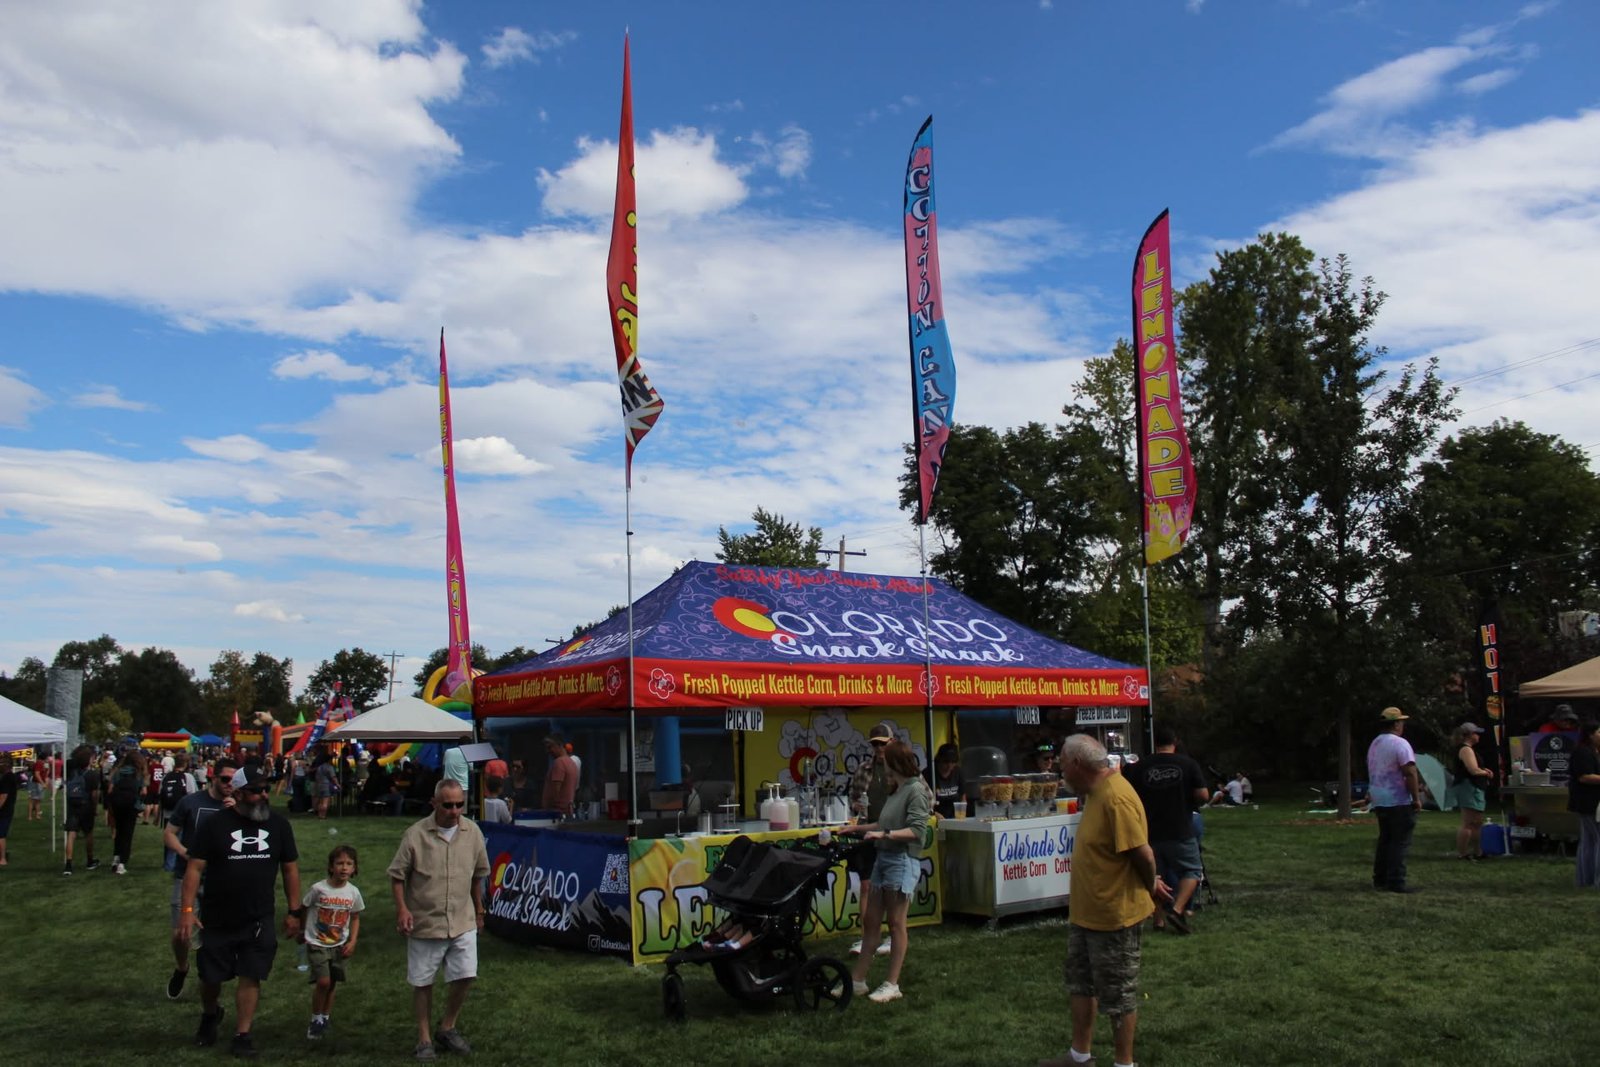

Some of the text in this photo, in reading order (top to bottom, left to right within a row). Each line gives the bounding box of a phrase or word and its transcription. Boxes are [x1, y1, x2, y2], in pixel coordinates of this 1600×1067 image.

[909, 164, 935, 337] COTTON
[1141, 247, 1187, 499] LEMONADE
[918, 346, 951, 480] CAN
[712, 596, 1008, 642] COLORADO
[771, 632, 1024, 662] Snack Shack
[1481, 624, 1499, 693] HOT
[486, 672, 605, 704] Fresh Popped Kettle Corn, Drinks & More
[684, 673, 912, 699] Fresh Popped Kettle Corn, Drinks & More
[945, 676, 1119, 699] Fresh Popped Kettle Corn, Drinks & More
[727, 709, 762, 731] PICK UP
[1017, 706, 1040, 724] ORDER
[998, 829, 1055, 862] Colorado
[489, 852, 580, 902] COLORADO
[1003, 858, 1072, 881] Kettle Corn Cott
[488, 887, 573, 932] Snack Shack
